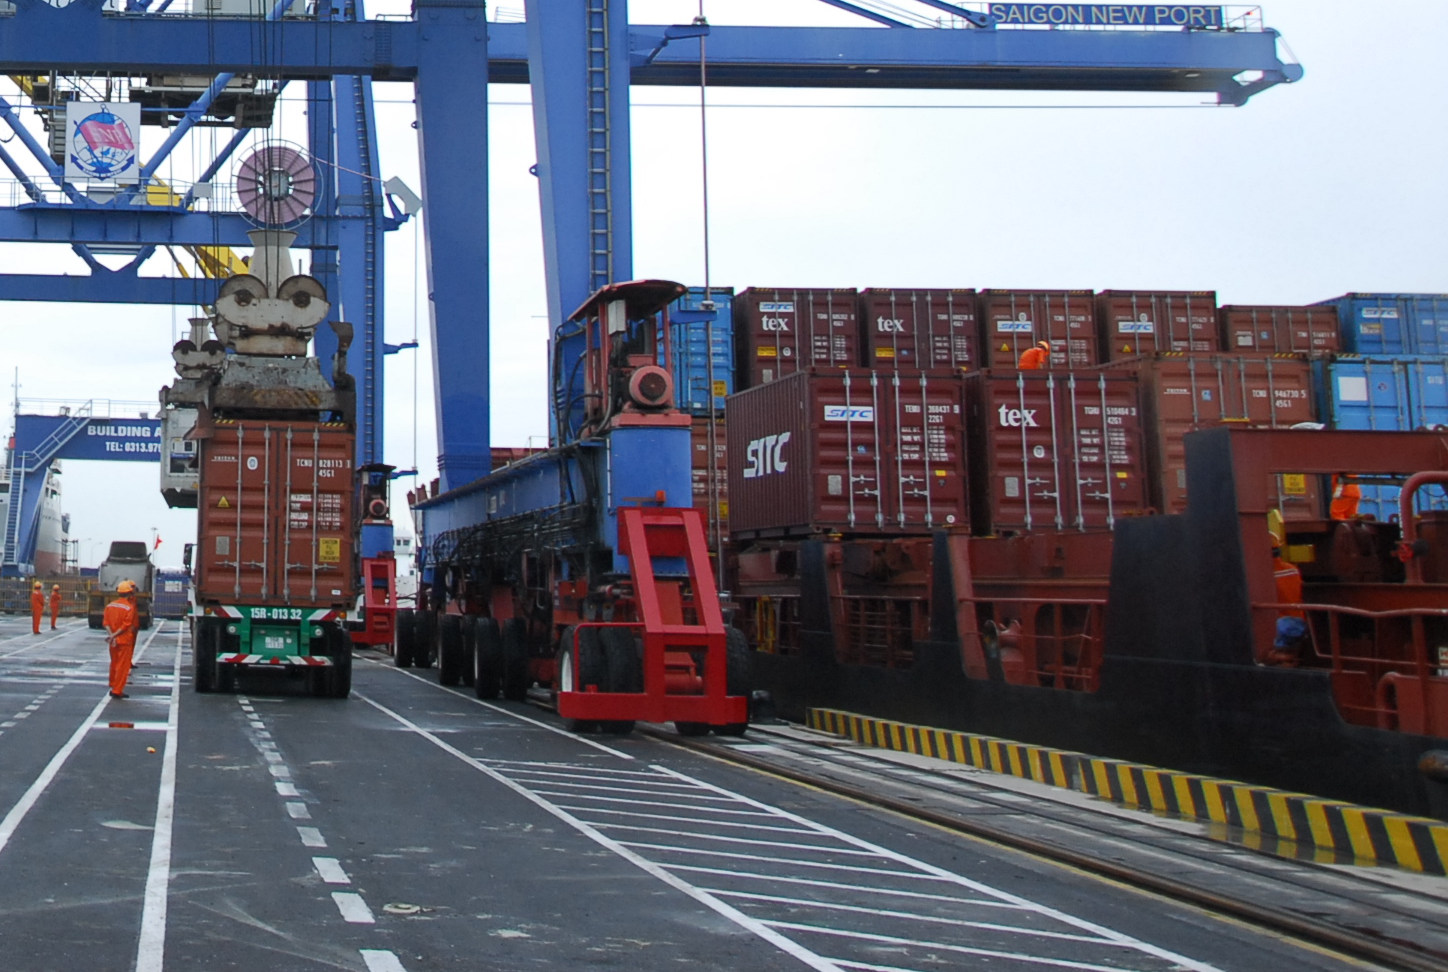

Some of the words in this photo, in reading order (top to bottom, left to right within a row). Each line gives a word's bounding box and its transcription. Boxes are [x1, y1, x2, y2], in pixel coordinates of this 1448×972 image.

[991, 4, 1083, 24] SAIGON
[1092, 5, 1145, 24] NEW
[1154, 6, 1220, 25] PORT
[761, 314, 790, 331] tex
[877, 315, 905, 332] tex
[826, 409, 872, 418] SITC
[998, 404, 1040, 427] tex
[87, 425, 151, 437] BUILDING
[105, 441, 123, 452] TEL:
[743, 432, 791, 478] SITC
